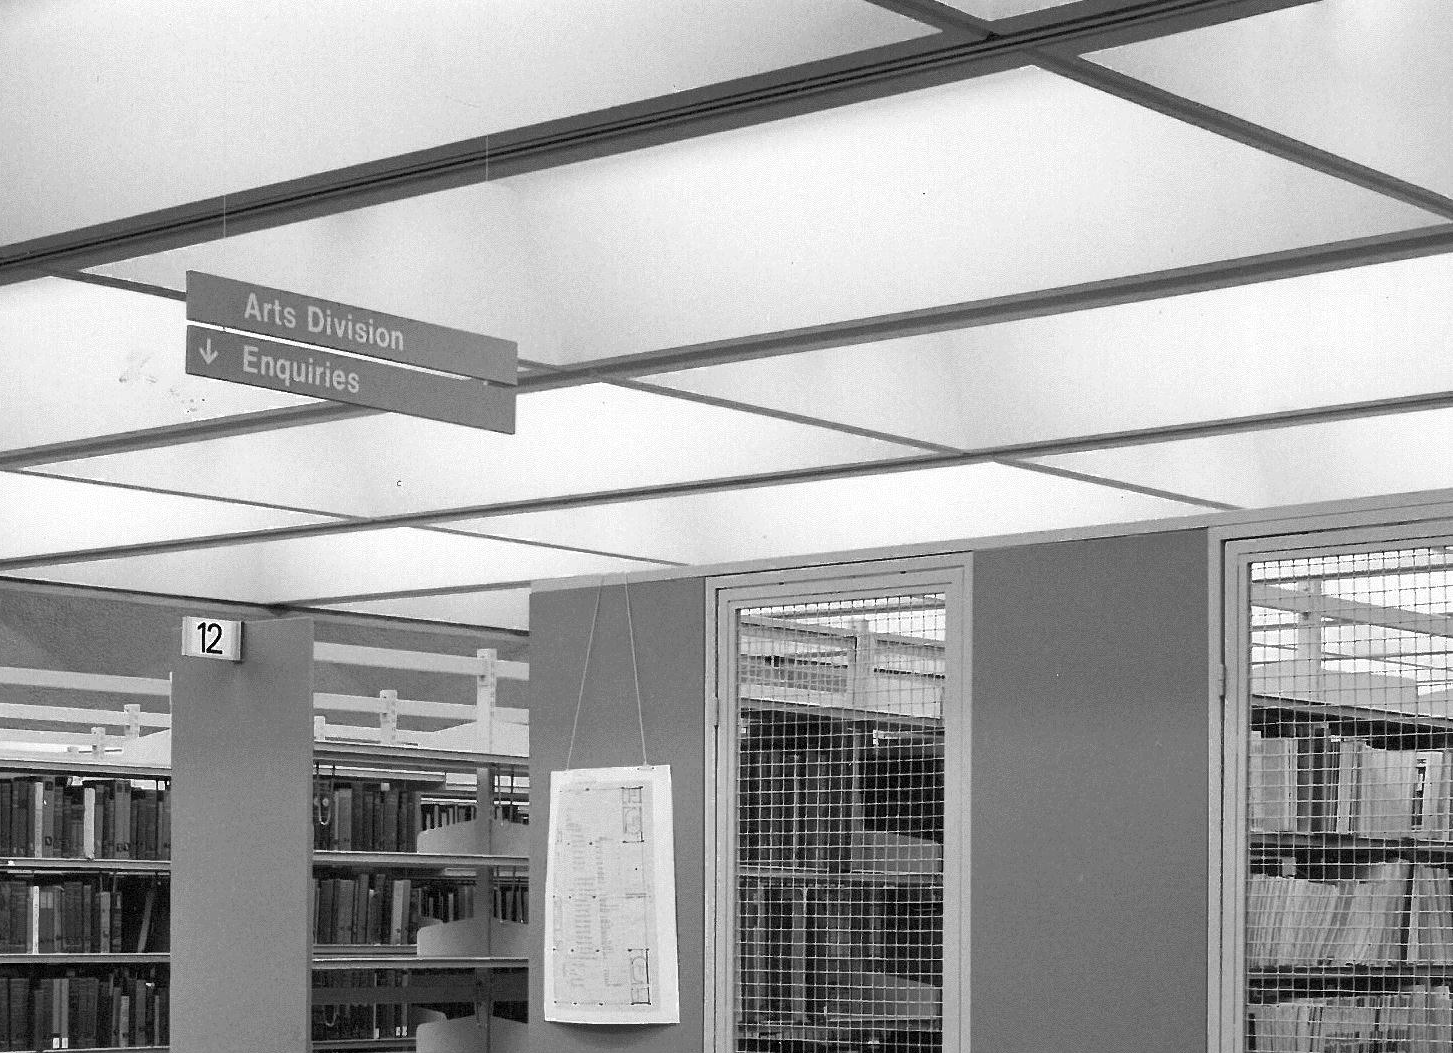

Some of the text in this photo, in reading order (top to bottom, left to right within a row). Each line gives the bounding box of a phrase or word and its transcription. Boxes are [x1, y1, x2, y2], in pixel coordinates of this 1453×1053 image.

[244, 292, 404, 351] Arts Division
[243, 344, 360, 393] Enquiries
[197, 621, 223, 655] 12
